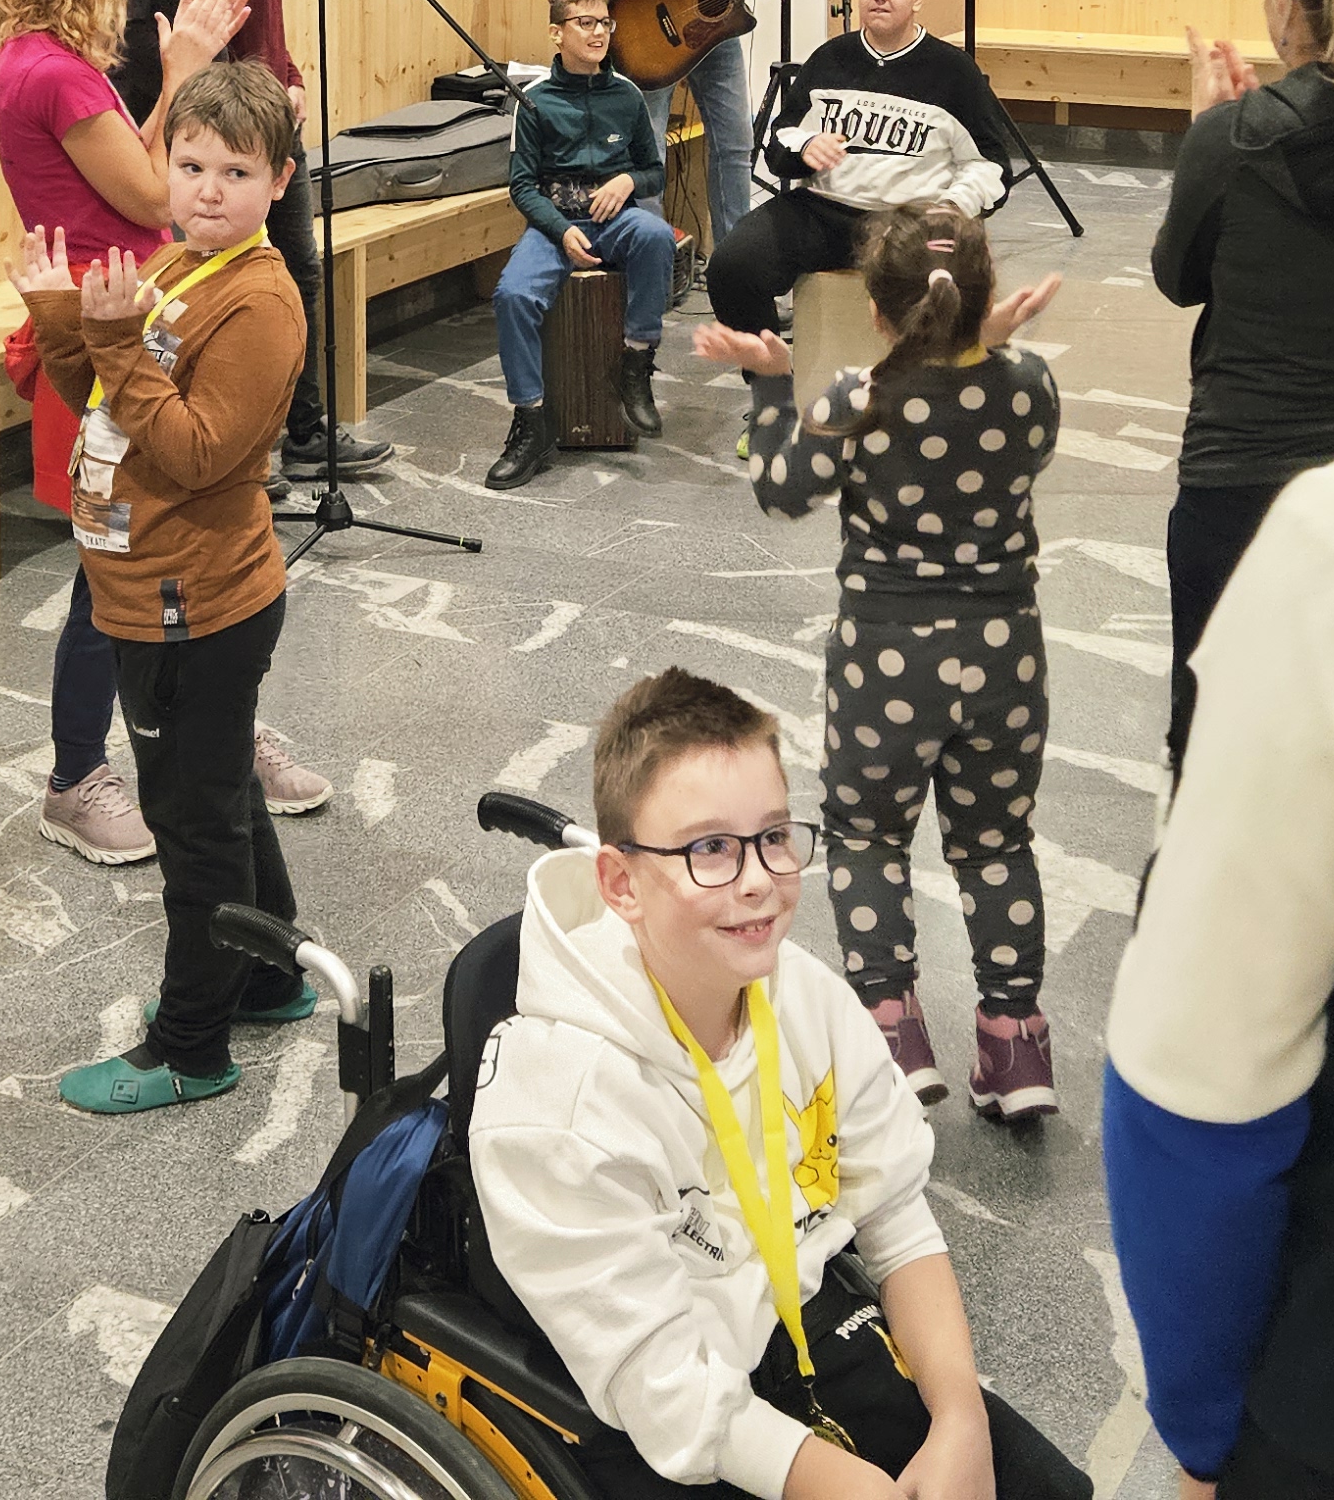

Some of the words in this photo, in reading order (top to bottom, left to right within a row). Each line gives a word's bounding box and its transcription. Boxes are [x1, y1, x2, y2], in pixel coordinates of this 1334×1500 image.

[818, 98, 937, 154] ROUGH
[856, 99, 876, 108] LOS
[881, 103, 927, 119] ANGELES
